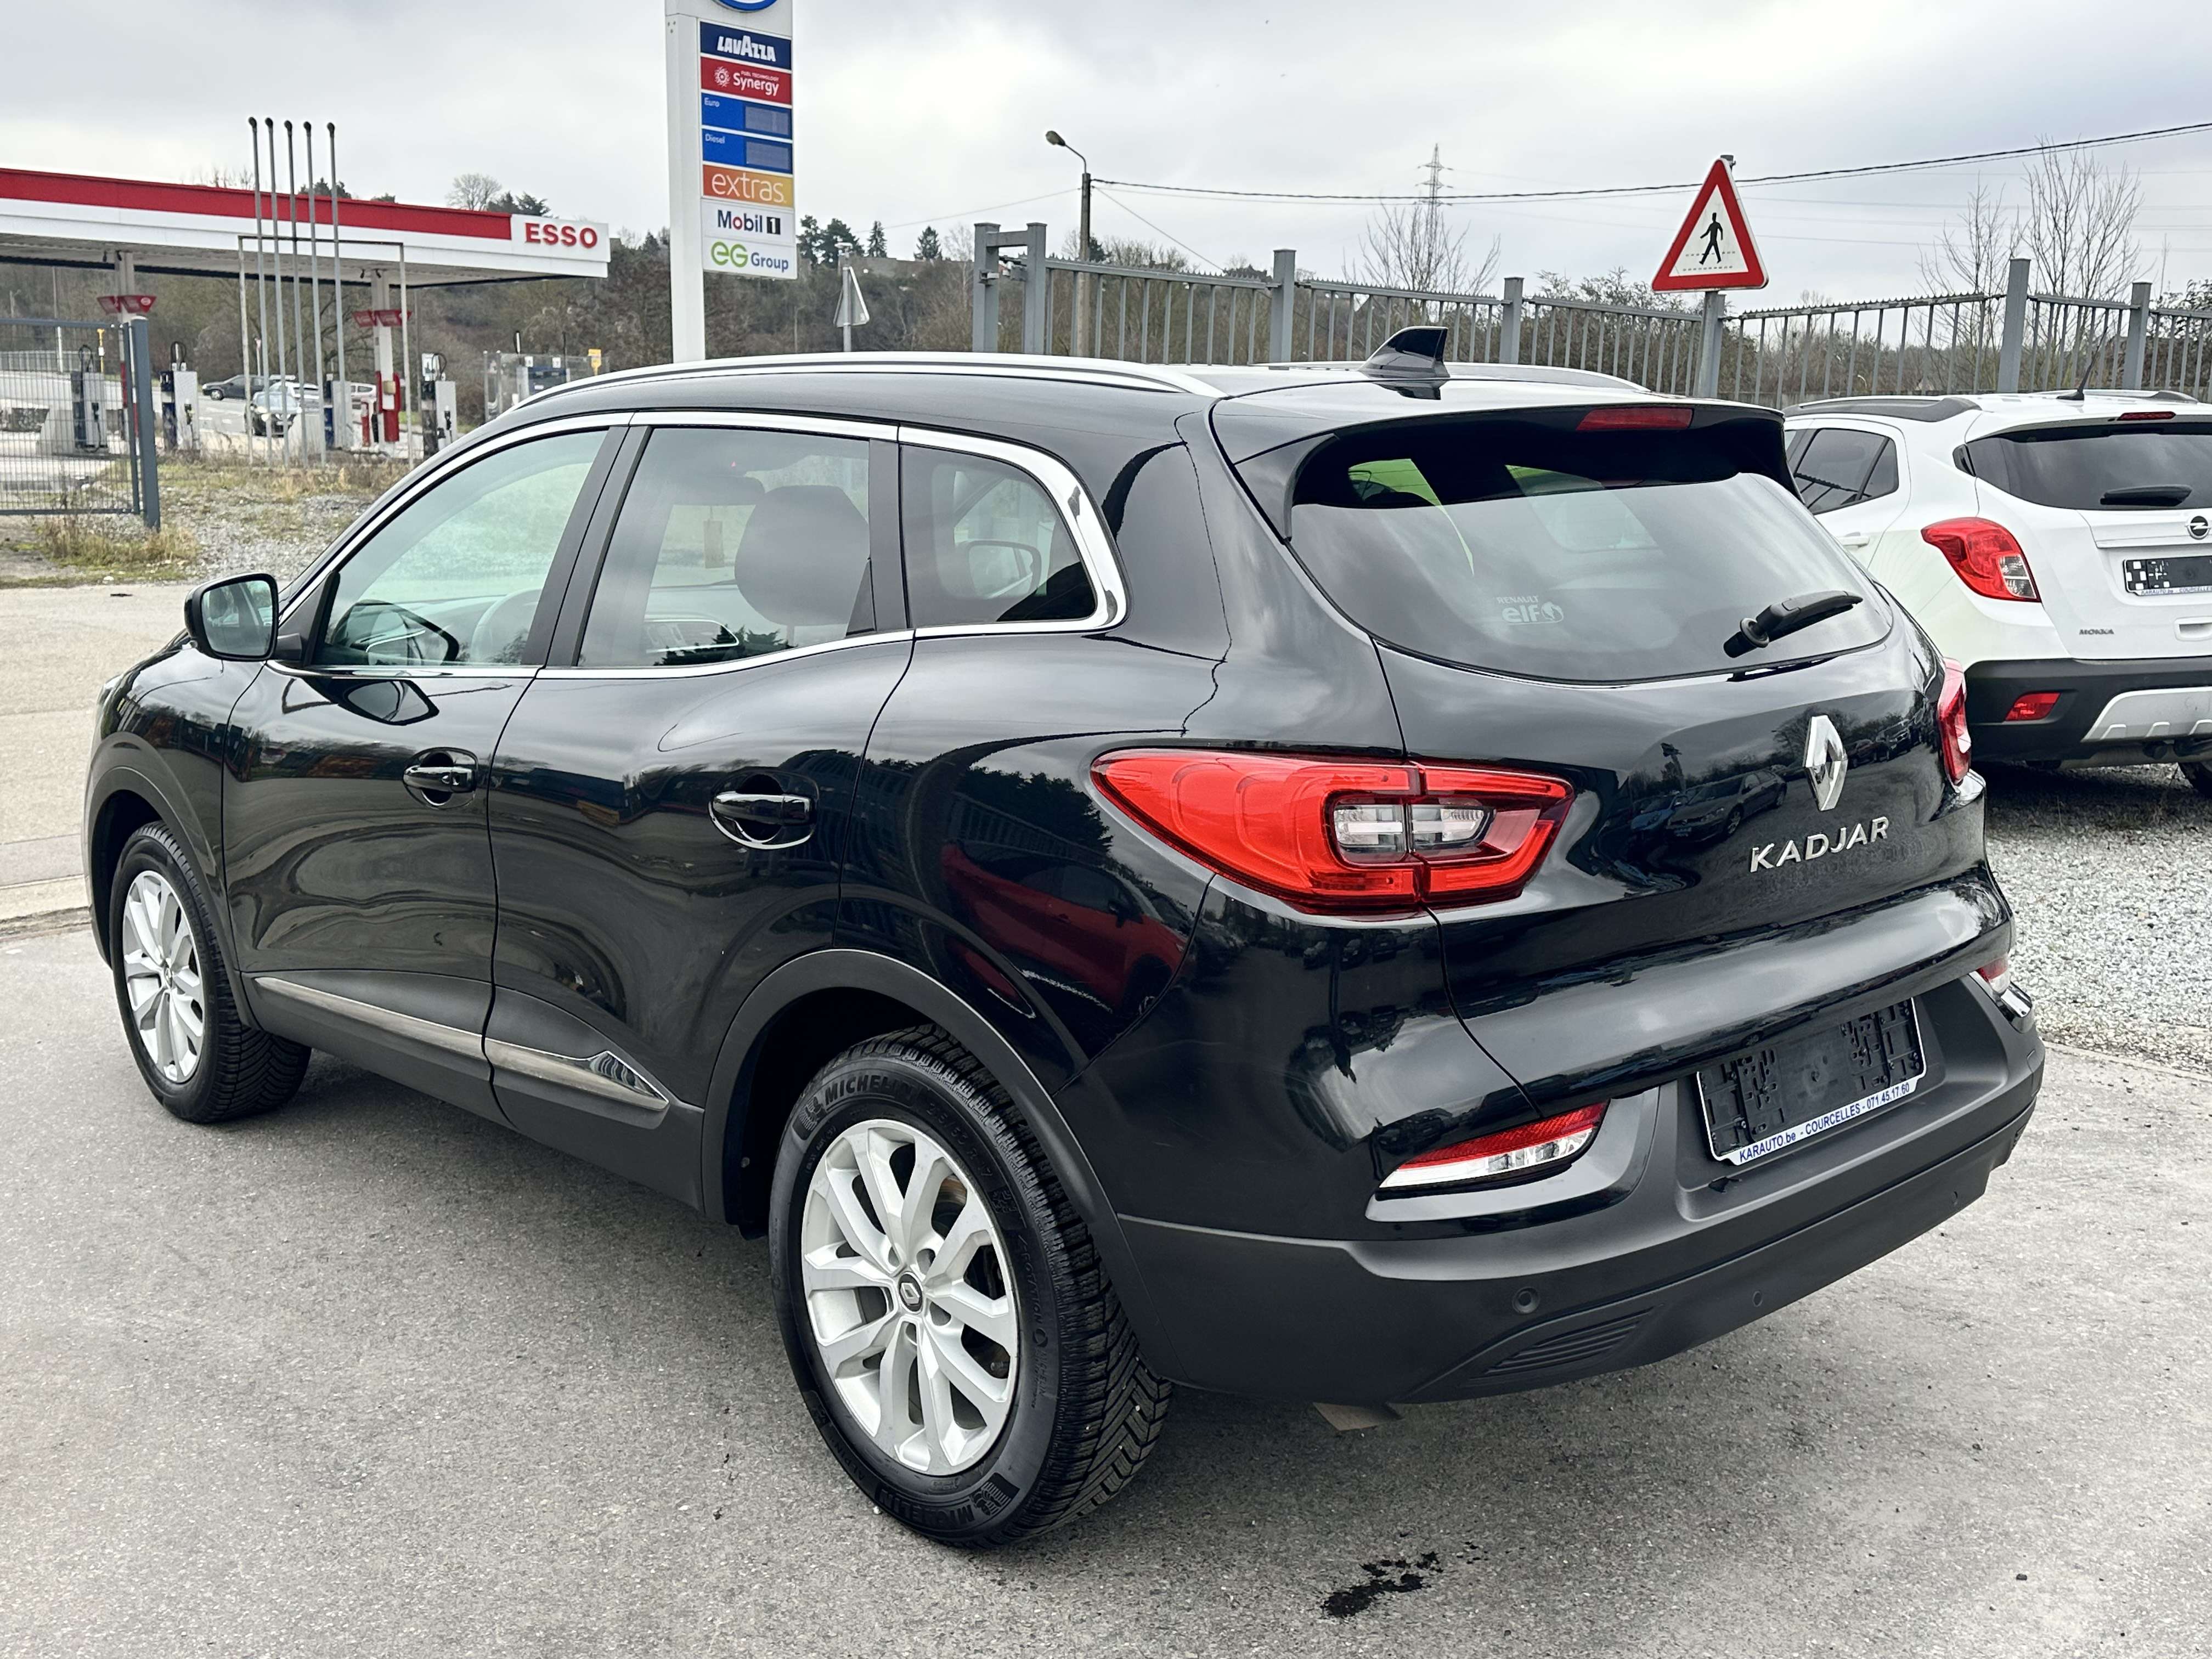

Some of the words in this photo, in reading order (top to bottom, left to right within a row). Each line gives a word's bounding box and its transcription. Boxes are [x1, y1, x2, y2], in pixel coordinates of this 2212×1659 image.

[716, 35, 776, 62] LAVAZZA
[733, 72, 780, 97] Synergy
[704, 97, 720, 108] Euro
[705, 133, 725, 144] Diesel
[712, 172, 784, 203] extras
[717, 210, 763, 233] Mobil
[768, 217, 778, 234] 1
[525, 222, 597, 249] ESSO
[751, 252, 789, 272] Group
[1496, 595, 1539, 604] RENAULT
[1502, 605, 1540, 623] elf
[1750, 816, 1889, 873] KADJAR
[1740, 1132, 1796, 1163] KARAUTO.be
[1805, 1103, 1860, 1135] COURCELLES
[1866, 1082, 1910, 1110] 071.45.17.60
